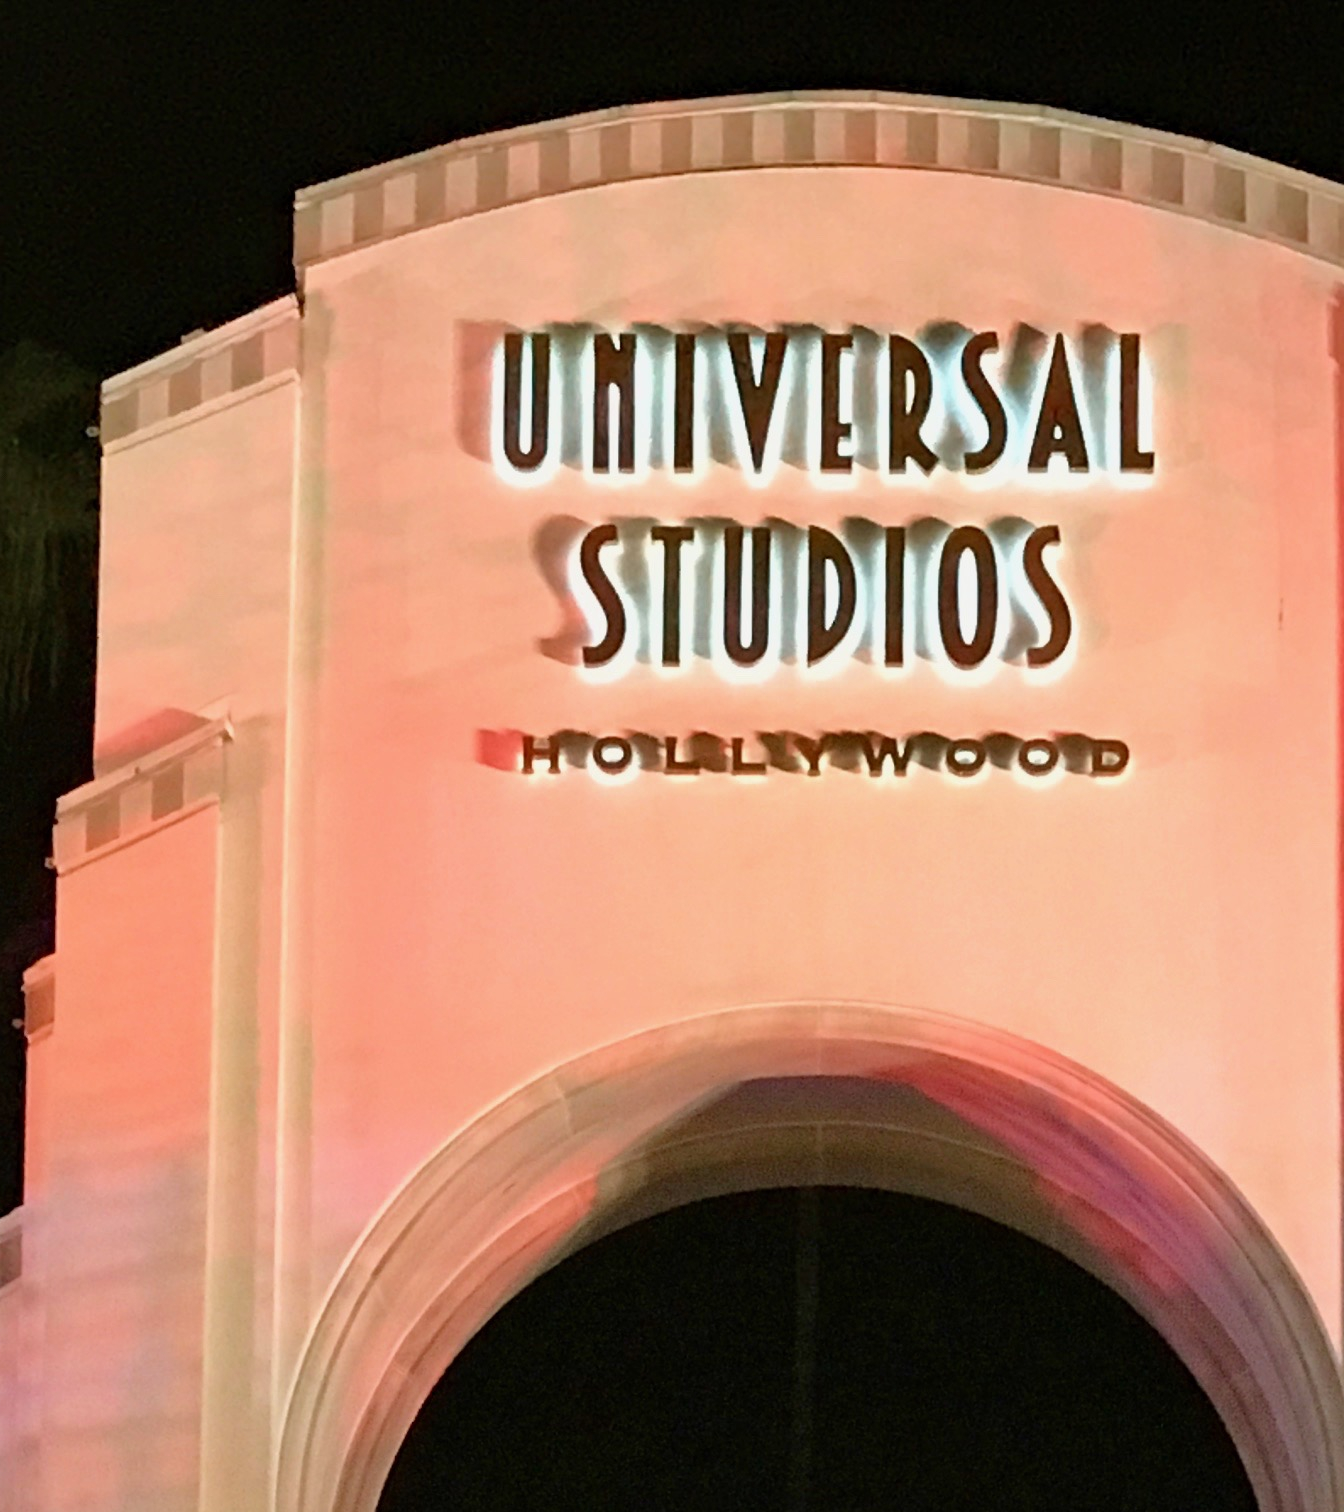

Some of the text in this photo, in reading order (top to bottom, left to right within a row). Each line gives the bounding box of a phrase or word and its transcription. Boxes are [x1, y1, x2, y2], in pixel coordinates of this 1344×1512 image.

[503, 332, 1156, 475] UNIVERSAL
[579, 523, 1072, 669] STUDIOS
[522, 736, 1131, 777] HOLLYWOOD
